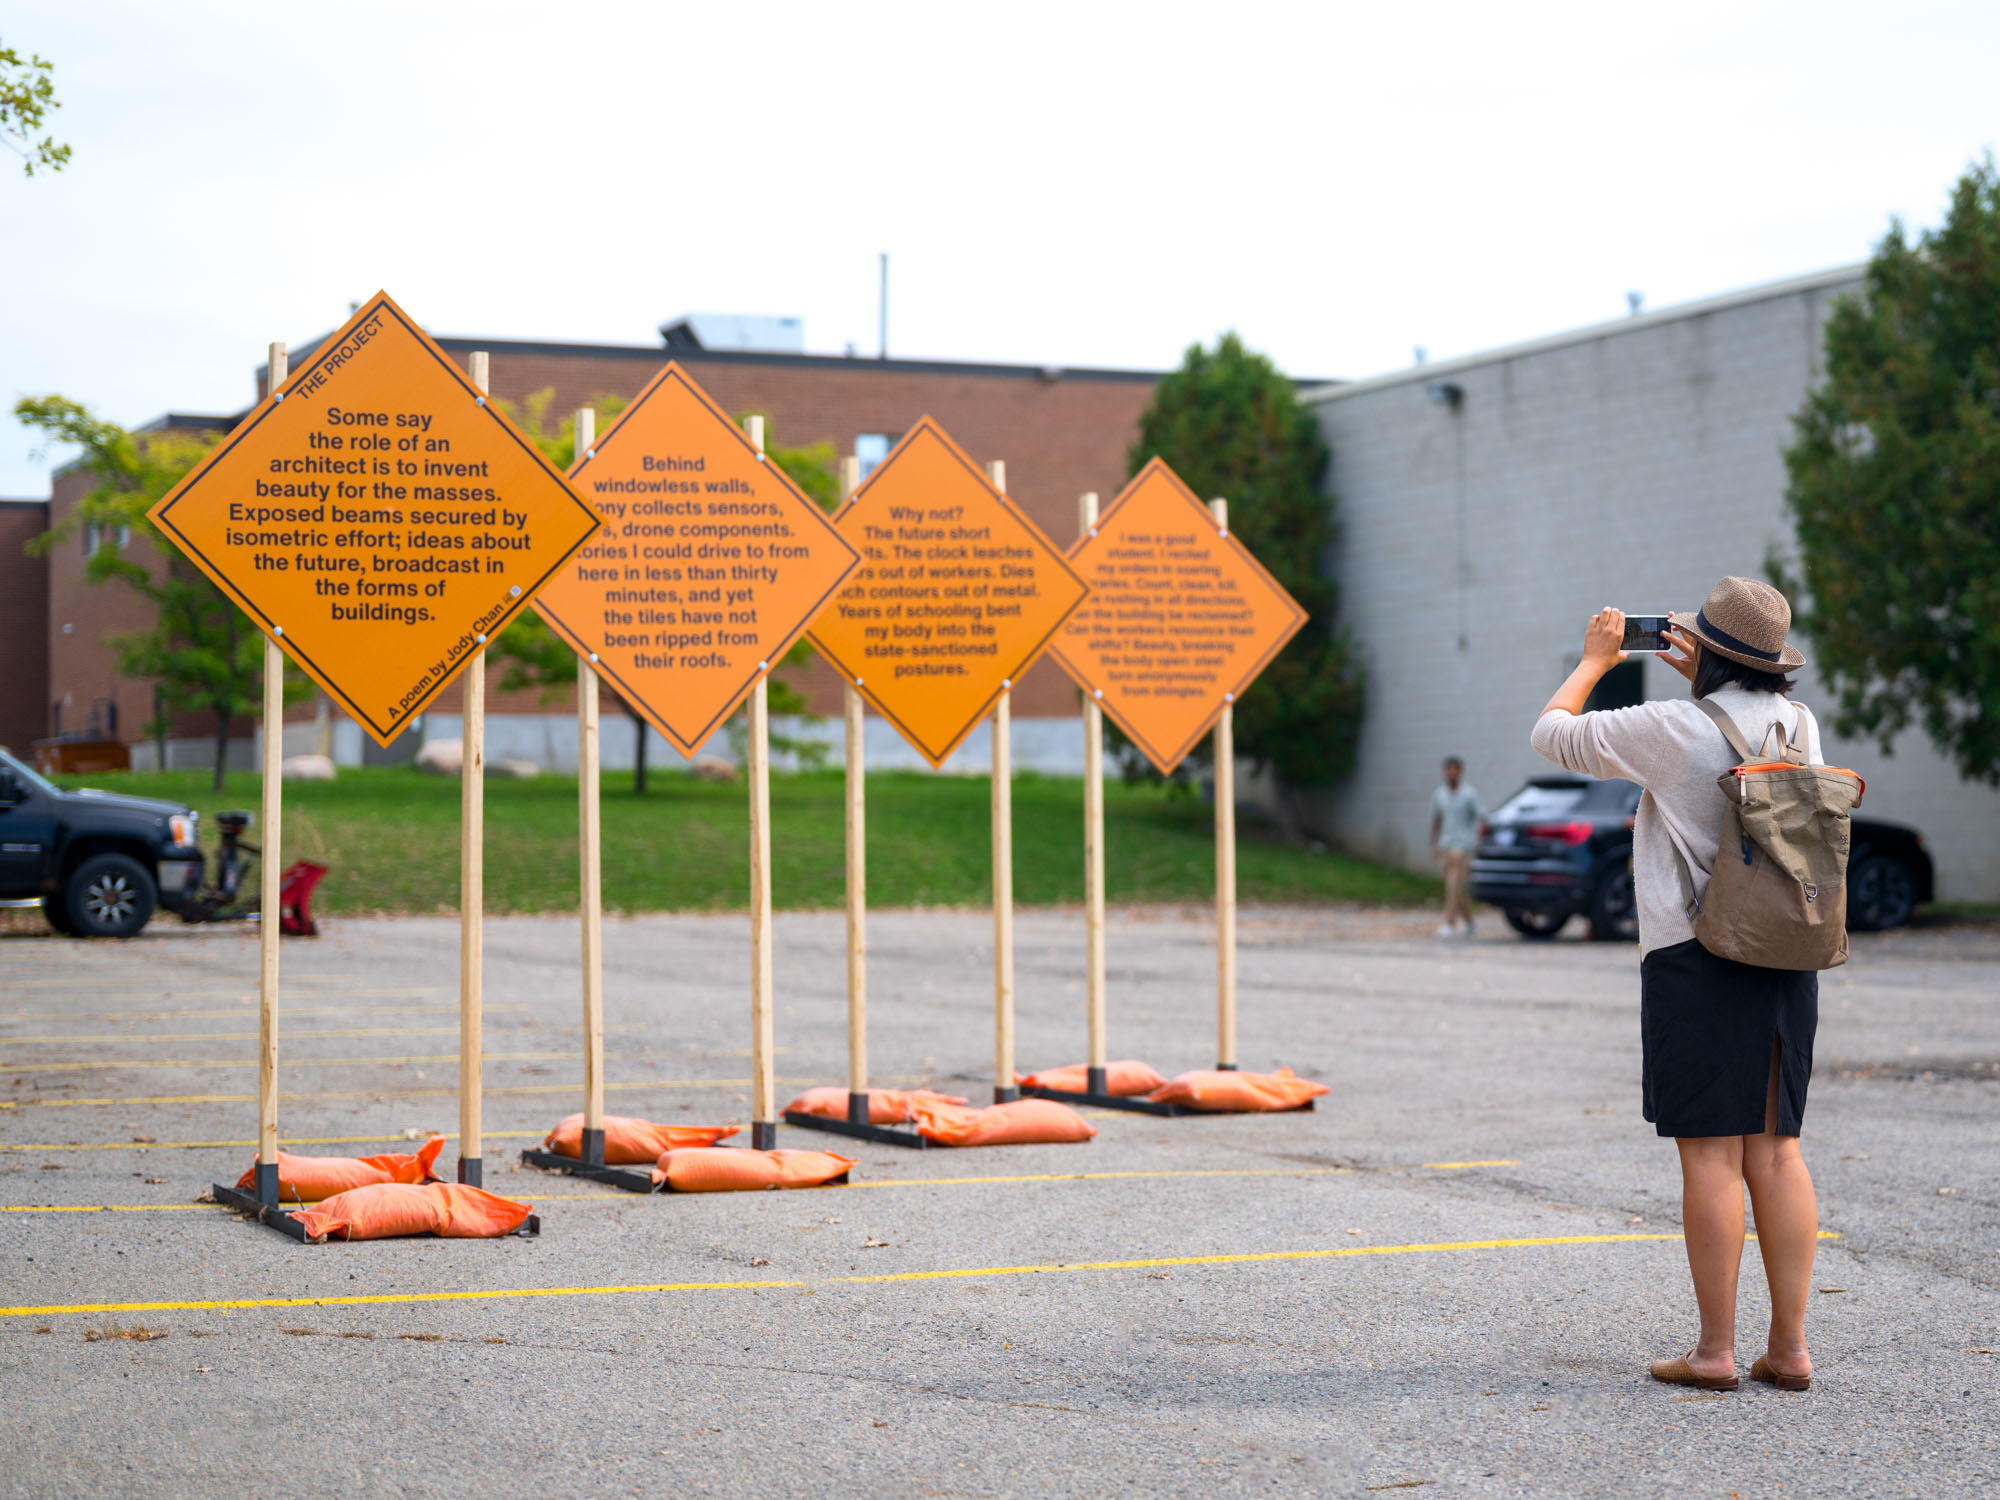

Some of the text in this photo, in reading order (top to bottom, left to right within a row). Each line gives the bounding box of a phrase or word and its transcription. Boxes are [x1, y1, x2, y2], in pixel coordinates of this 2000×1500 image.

[296, 315, 384, 399] THE PROJECT
[328, 408, 432, 432] Some say
[309, 431, 449, 452] the role of an
[270, 456, 488, 477] architect is to invent
[643, 456, 704, 471] Behind
[256, 480, 501, 503] beauty for the masses.
[594, 478, 754, 496] windowless walls,
[230, 503, 527, 530] Exposed beams secured by
[632, 500, 702, 515] collects
[708, 504, 783, 517] sensors,
[890, 507, 963, 524] Why not?
[226, 528, 531, 552] isometric effort; ideas about
[622, 522, 674, 537] drone
[680, 523, 794, 540] components.
[865, 526, 990, 540] The future short
[578, 543, 808, 559] ories I could drive to from
[894, 545, 922, 560] The
[927, 546, 968, 560] clock
[973, 546, 1033, 558] leaches
[254, 552, 503, 575] the future, broadcast in
[879, 566, 904, 579] out
[909, 566, 924, 579] of
[929, 565, 996, 579] workers.
[1001, 564, 1034, 578] Dies
[578, 565, 777, 583] here in less than thirty
[316, 578, 445, 597] the forms of
[606, 587, 752, 605] minutes, and yet
[870, 586, 939, 598] contours
[944, 585, 968, 598] out
[973, 584, 988, 597] of
[993, 584, 1041, 596] metal.
[332, 603, 435, 625] buildings.
[604, 609, 756, 624] the tiles have not
[838, 604, 1020, 621] Years of schooling bent
[605, 630, 758, 649] been ripped from
[865, 623, 995, 641] my body into the
[865, 643, 997, 657] state-sanctioned
[388, 603, 504, 719] A poem by Jody Chan
[634, 652, 731, 668] their roofs.
[895, 663, 969, 679] postures.
